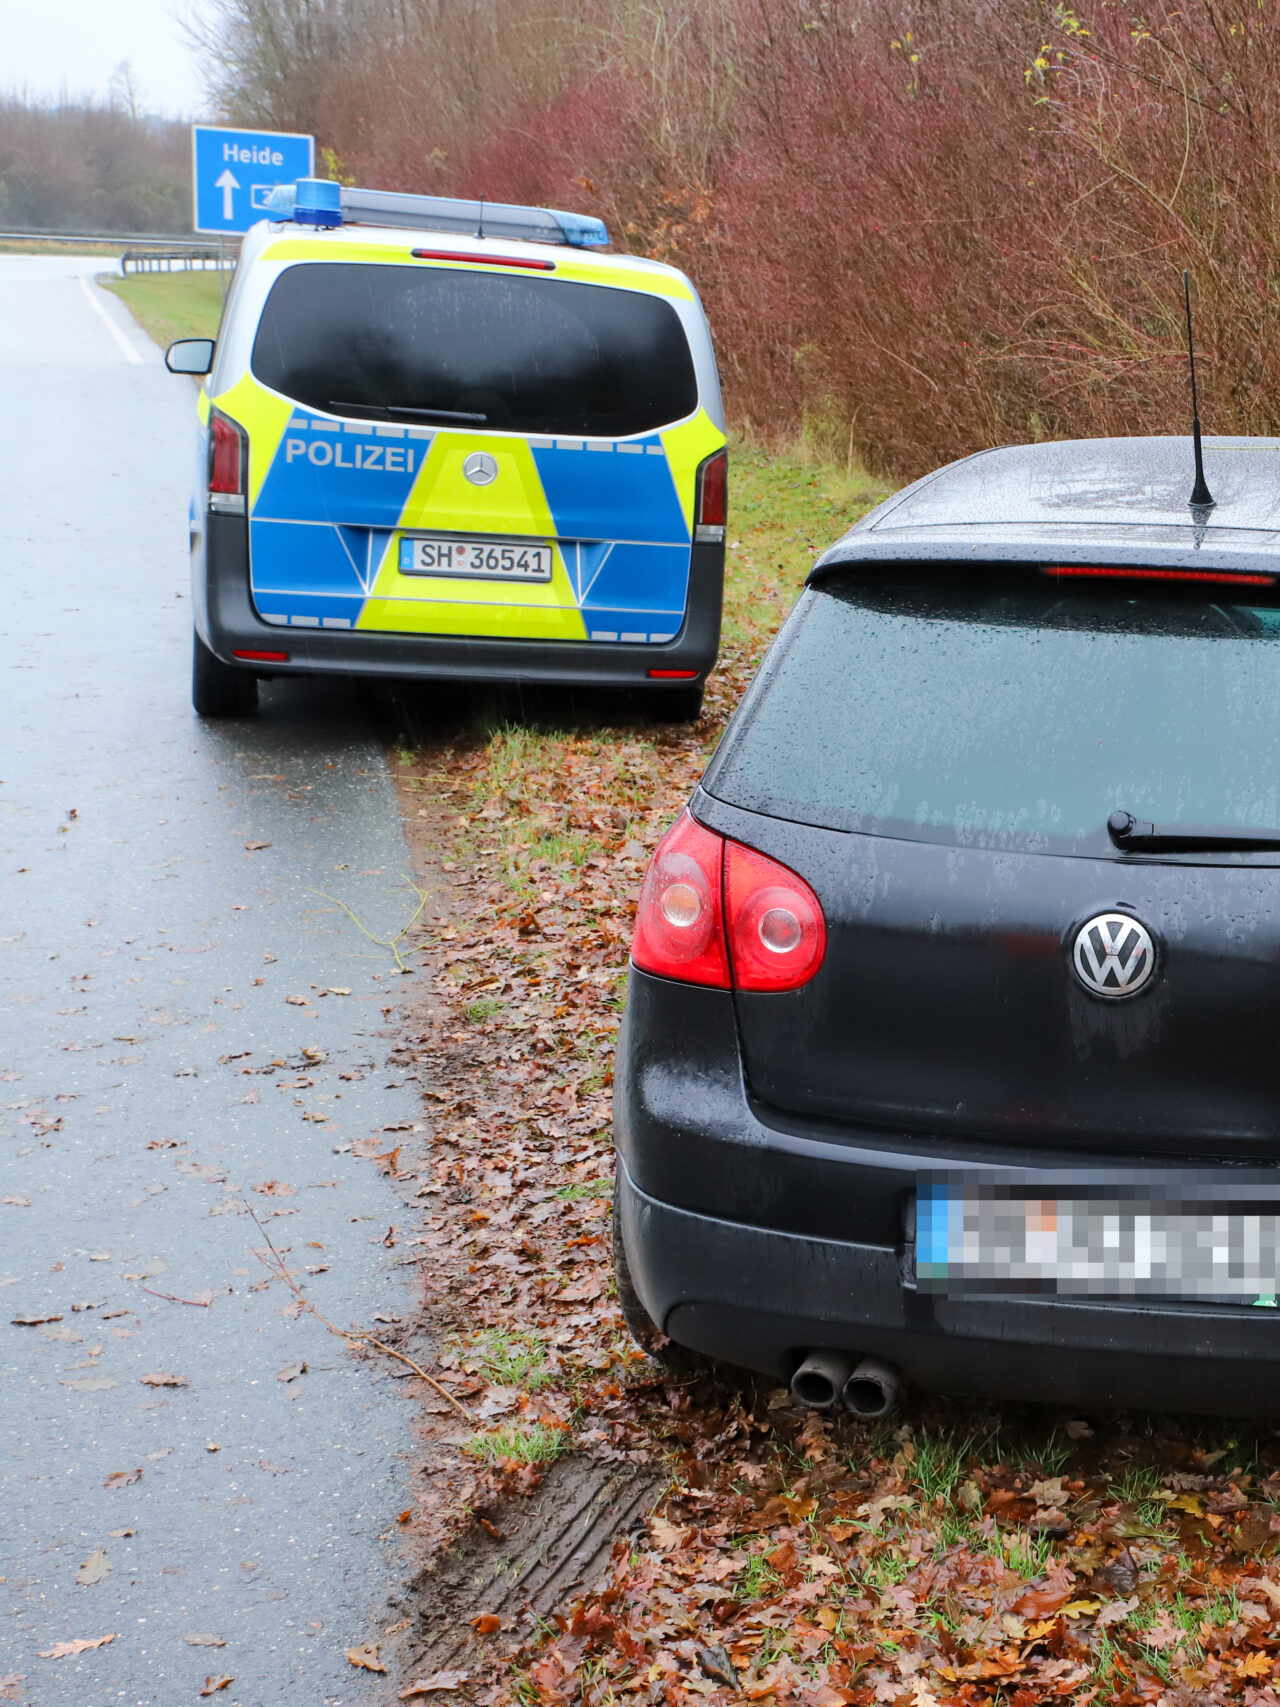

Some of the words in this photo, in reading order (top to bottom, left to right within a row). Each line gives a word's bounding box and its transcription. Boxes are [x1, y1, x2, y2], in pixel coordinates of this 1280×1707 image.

[223, 143, 283, 165] Heide
[286, 438, 414, 472] POLIZEI
[420, 543, 453, 568] SH
[469, 546, 546, 574] 36541
[1076, 916, 1151, 992] VW
